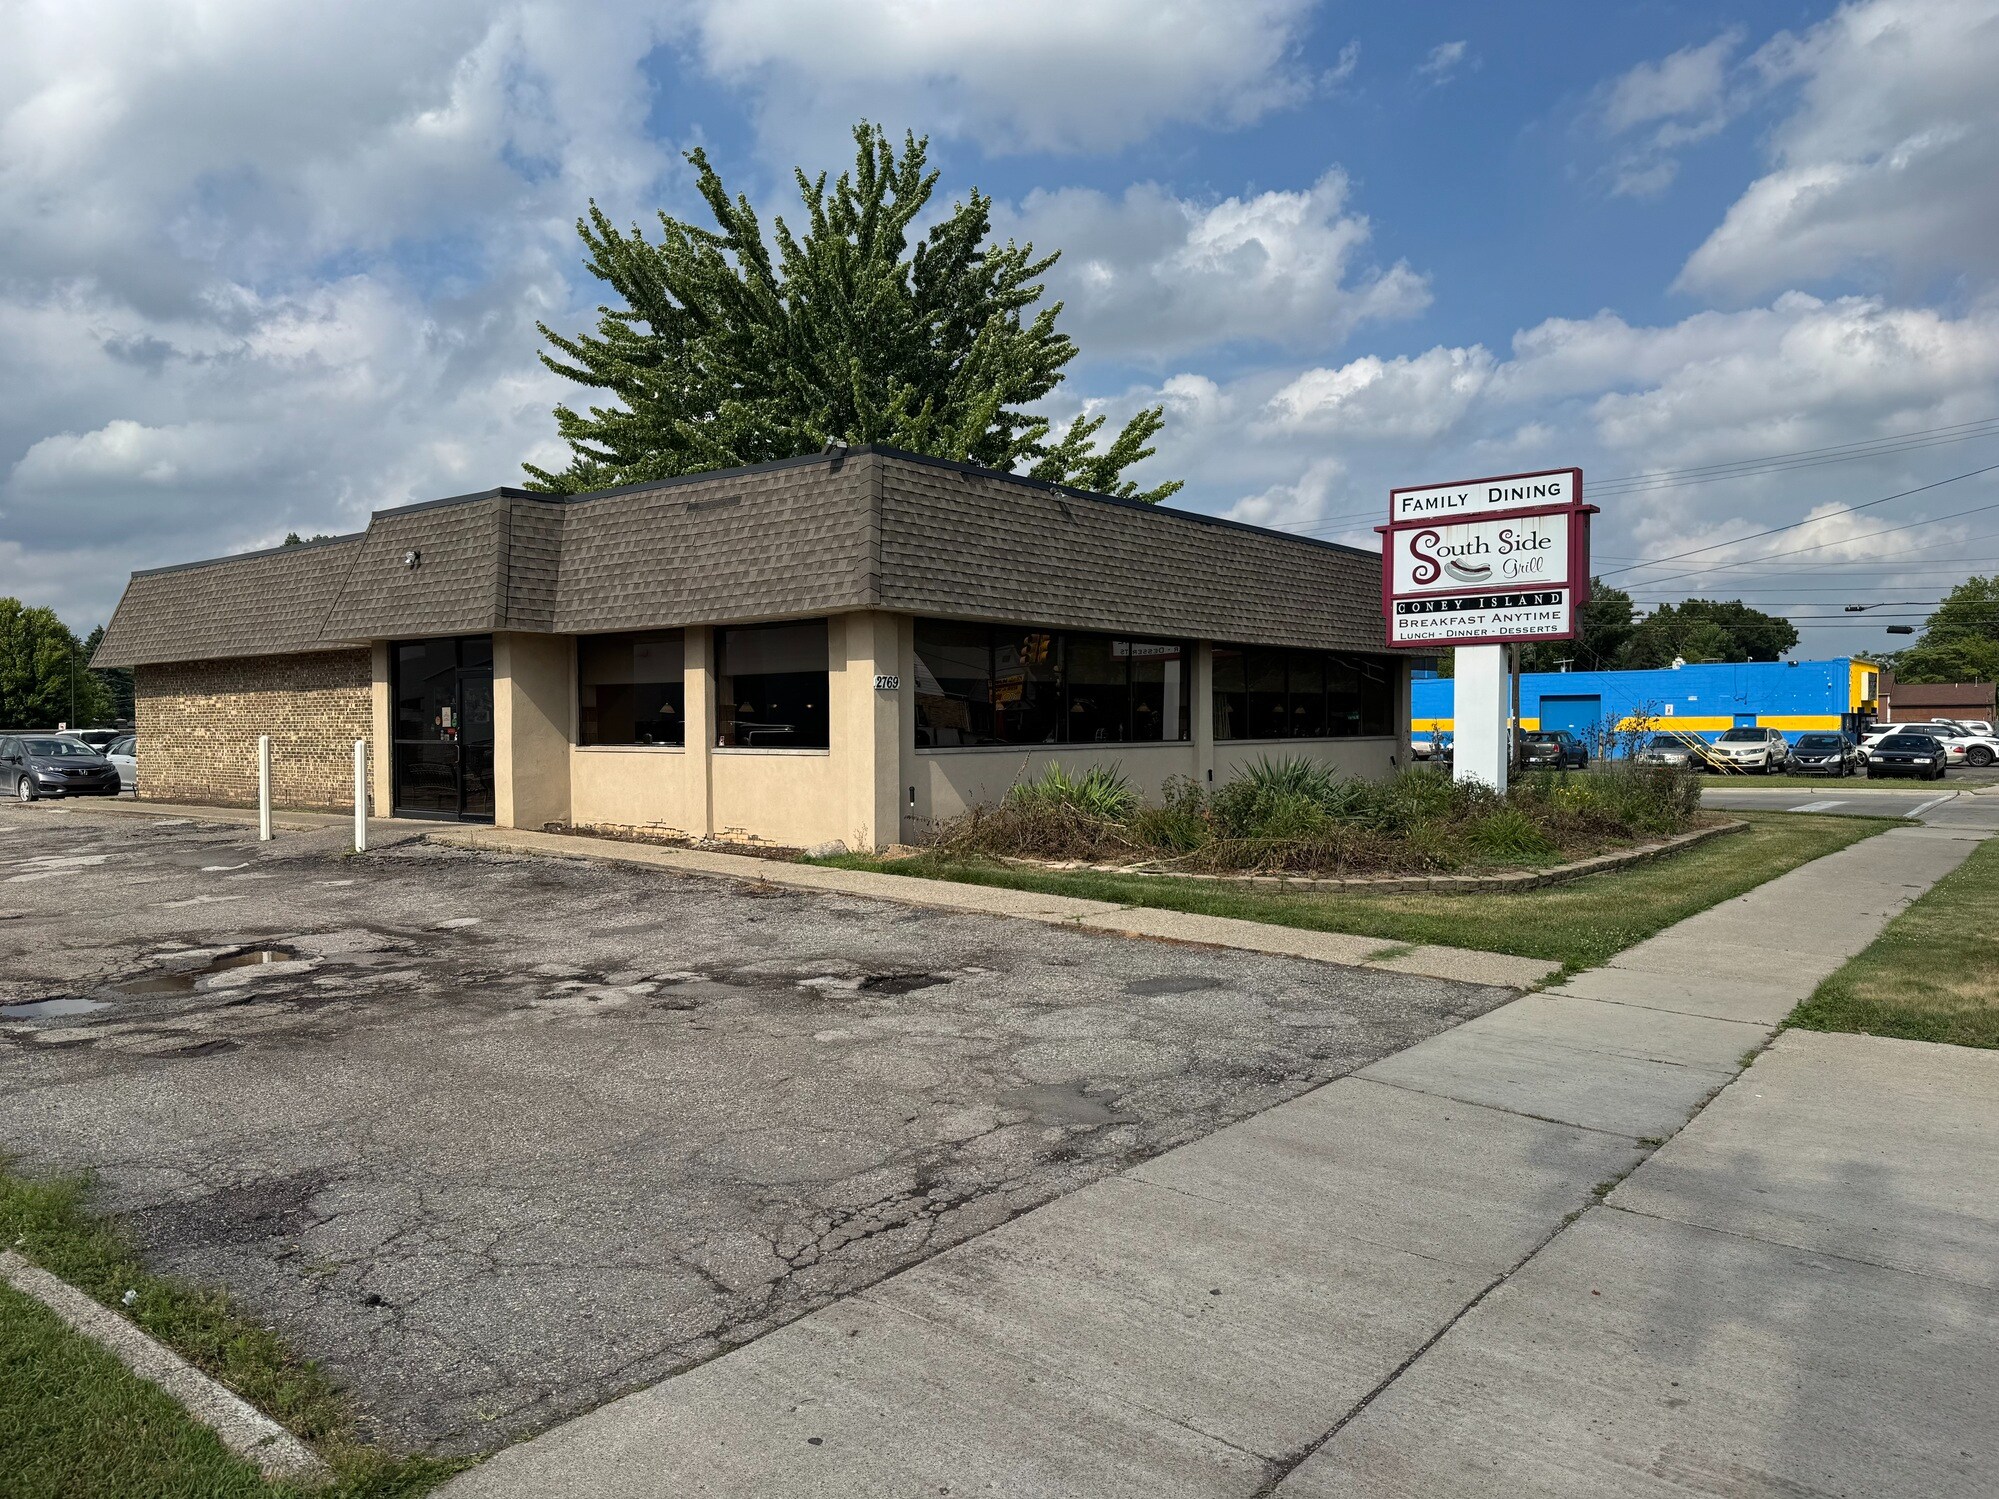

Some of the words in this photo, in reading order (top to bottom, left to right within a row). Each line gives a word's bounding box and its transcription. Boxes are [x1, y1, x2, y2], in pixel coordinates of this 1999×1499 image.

[1402, 493, 1468, 513] FAMILY
[1488, 483, 1561, 503] DINING
[1409, 530, 1491, 585] South
[1498, 529, 1552, 555] Side
[1502, 556, 1544, 579] Grill
[1398, 600, 1463, 614] CONEY
[1479, 593, 1560, 608] ISLAND
[1399, 615, 1485, 628] BREAKFAST
[1491, 611, 1561, 623] ANYTIME
[1400, 631, 1435, 640] LUNCH
[1446, 628, 1488, 637] DINNER
[1499, 624, 1558, 635] DESSERTS
[876, 676, 899, 689] 2769
